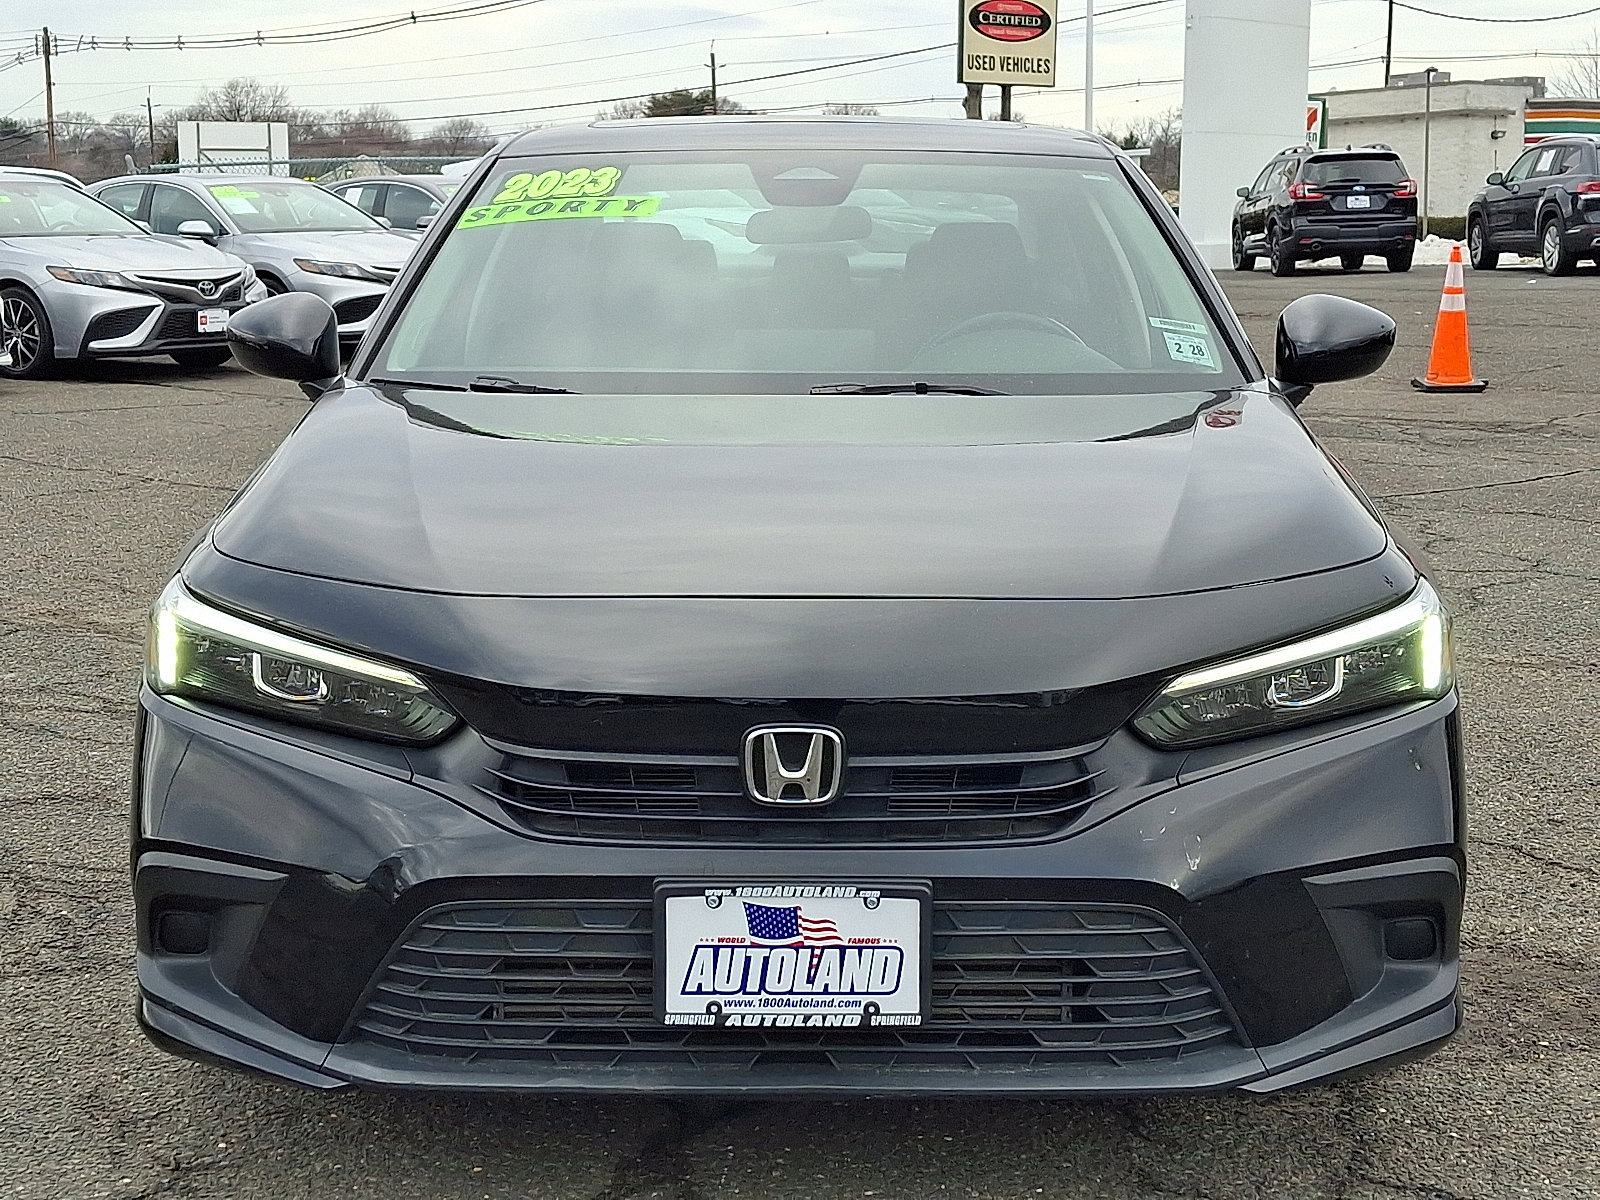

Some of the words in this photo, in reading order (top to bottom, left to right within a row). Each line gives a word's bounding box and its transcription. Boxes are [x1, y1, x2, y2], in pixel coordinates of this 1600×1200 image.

[979, 11, 1041, 27] CERTIFIED
[967, 54, 996, 71] USED
[999, 56, 1051, 74] VEHICLES
[493, 166, 622, 204] 2023
[464, 199, 648, 223] SPORTY
[1174, 342, 1184, 354] 2
[1189, 344, 1205, 357] 28
[680, 945, 904, 995] AUTOLAND
[723, 998, 862, 1009] www.1800Autoland.com
[664, 1014, 716, 1026] SPRINGFIELD
[724, 1014, 862, 1027] AUTOLAND
[870, 1015, 921, 1026] SPRINGFIELD
